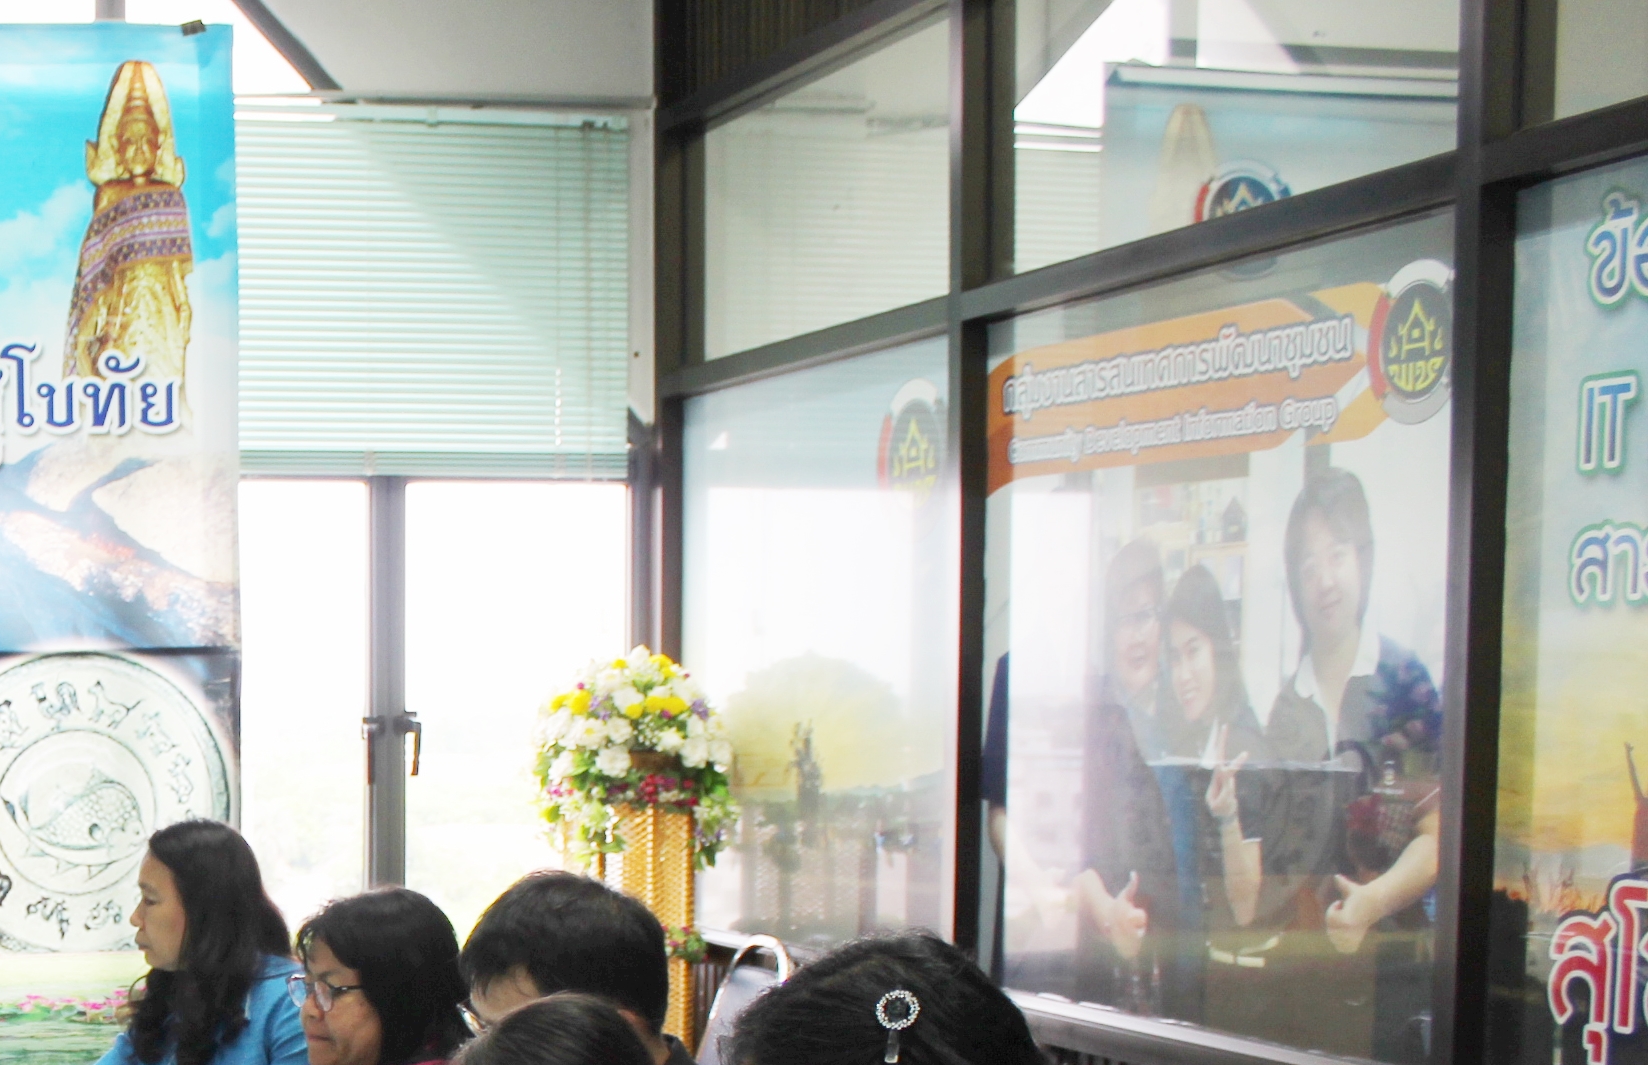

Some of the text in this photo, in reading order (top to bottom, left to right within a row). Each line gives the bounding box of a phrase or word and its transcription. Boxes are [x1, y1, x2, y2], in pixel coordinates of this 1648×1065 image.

[1083, 413, 1182, 456] Development
[1183, 401, 1277, 441] Information
[1278, 396, 1338, 434] Group
[1580, 377, 1637, 471] IT
